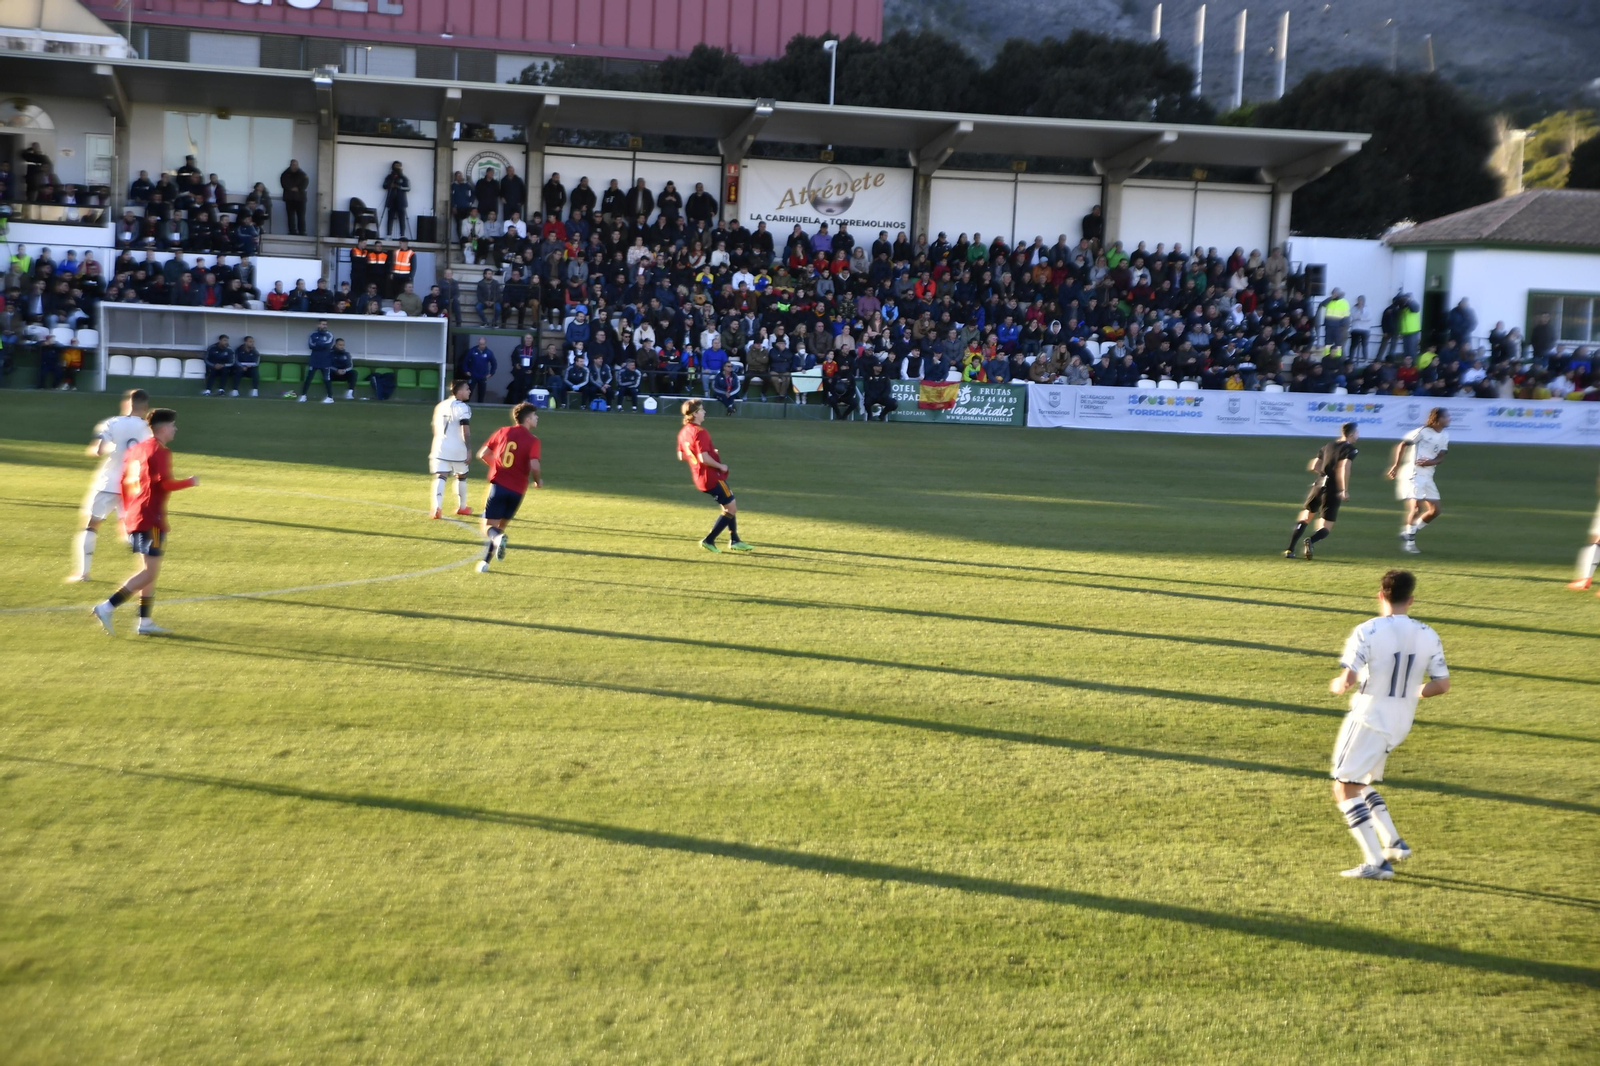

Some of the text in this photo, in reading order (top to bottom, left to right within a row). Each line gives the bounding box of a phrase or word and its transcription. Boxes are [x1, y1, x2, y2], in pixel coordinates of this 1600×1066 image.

[776, 172, 885, 210] Atrévete
[765, 215, 820, 224] CARIHUELA
[830, 218, 906, 229] TORREMOLINOS
[892, 384, 916, 392] OTEL
[892, 393, 920, 401] ESPAD
[1128, 409, 1203, 417] TORREMOLINOS
[1308, 415, 1383, 424] TORREMOLINOS
[502, 441, 517, 468] 6
[1388, 651, 1416, 698] 11
